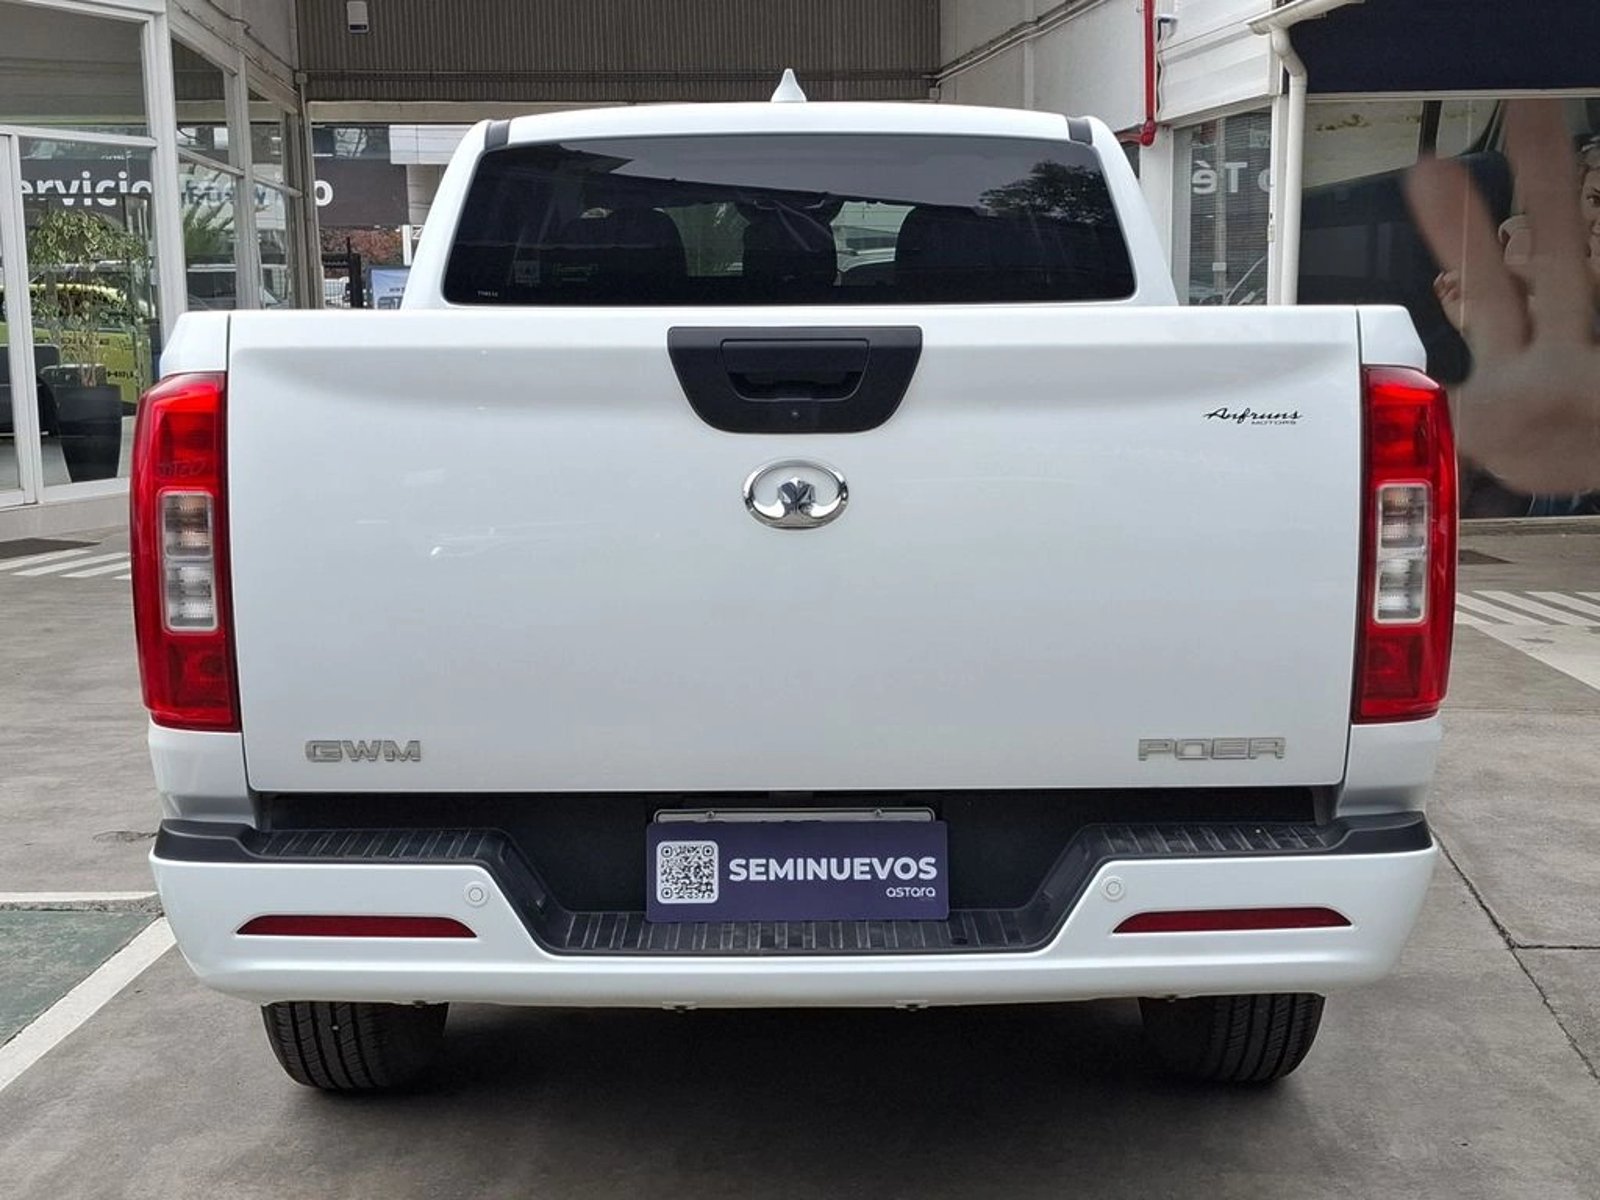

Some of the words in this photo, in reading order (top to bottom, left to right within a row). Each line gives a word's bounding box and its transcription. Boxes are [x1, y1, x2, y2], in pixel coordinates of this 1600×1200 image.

[305, 739, 421, 763] GWM
[1138, 737, 1285, 761] POER
[729, 857, 937, 881] SEMINUEVOS
